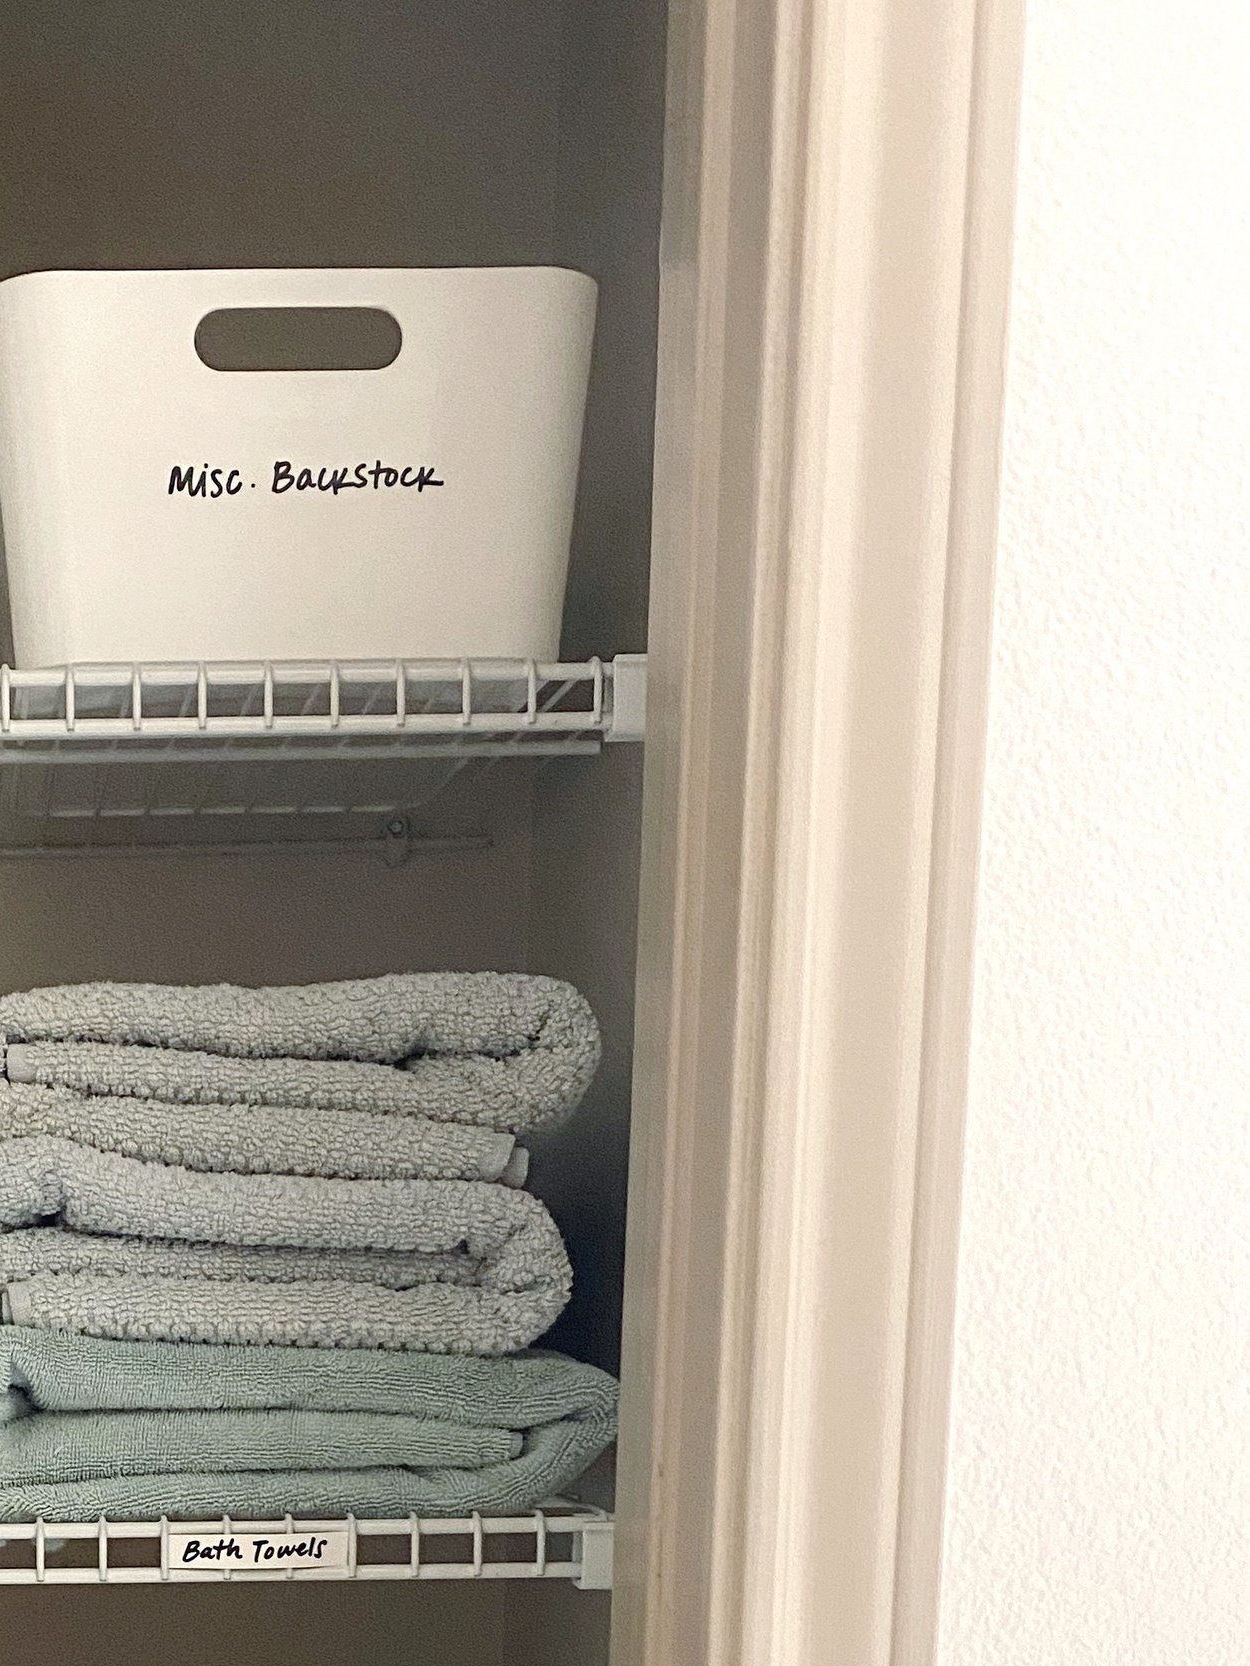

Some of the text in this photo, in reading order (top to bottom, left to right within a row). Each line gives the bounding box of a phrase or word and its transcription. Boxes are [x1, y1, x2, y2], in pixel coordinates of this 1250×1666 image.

[168, 460, 444, 498] Misc. Backstock
[182, 1537, 327, 1563] Bath Towels
